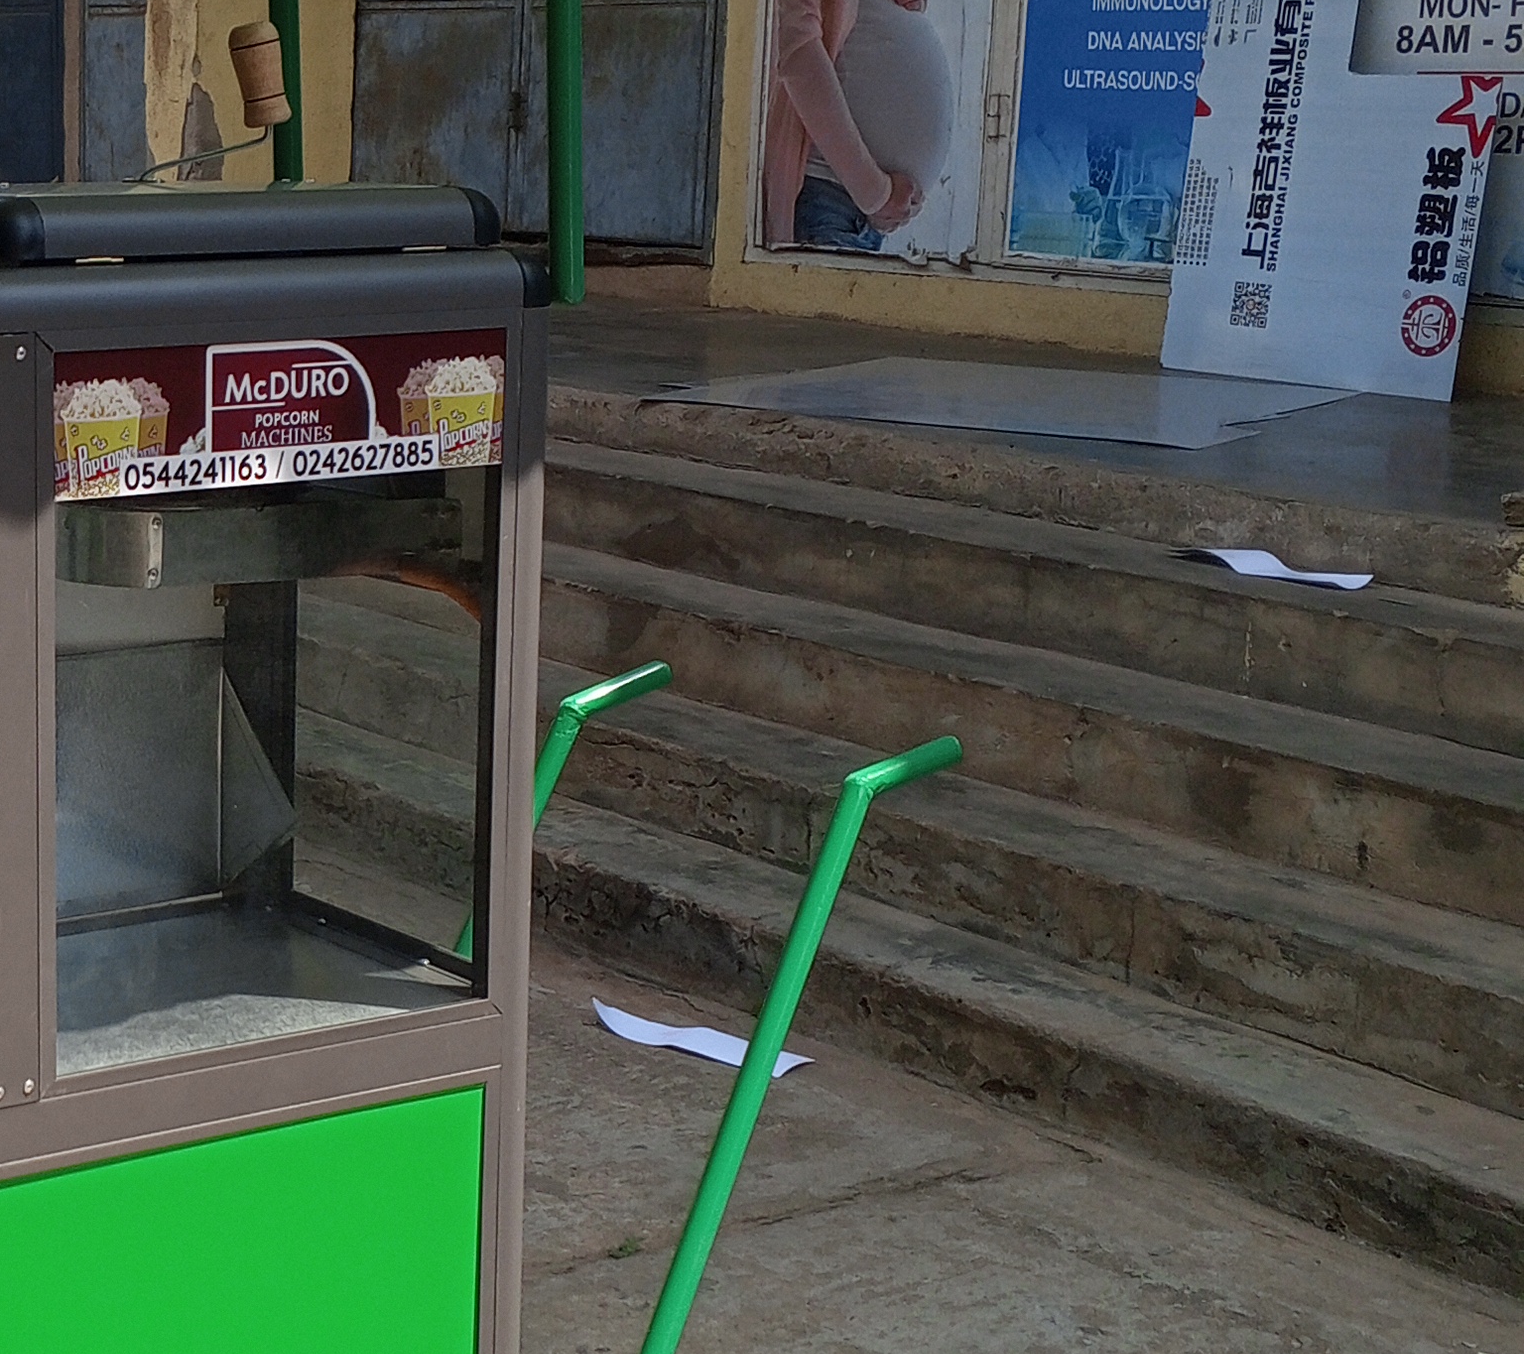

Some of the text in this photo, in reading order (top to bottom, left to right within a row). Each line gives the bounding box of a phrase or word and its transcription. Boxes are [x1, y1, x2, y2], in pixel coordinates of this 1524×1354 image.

[1087, 31, 1123, 50] DNA
[1396, 24, 1471, 54] 8AM
[1267, 185, 1288, 273] SHANGHAI
[1281, 115, 1298, 182] JIXIANG
[1290, 6, 1314, 108] COMPOSITE
[1407, 147, 1467, 285] 铝塑板
[223, 367, 350, 403] McDURO
[254, 409, 320, 428] POPCORN
[240, 425, 333, 449] MACHINES
[124, 451, 268, 491] 0544241163
[292, 439, 434, 478] 0242627885
